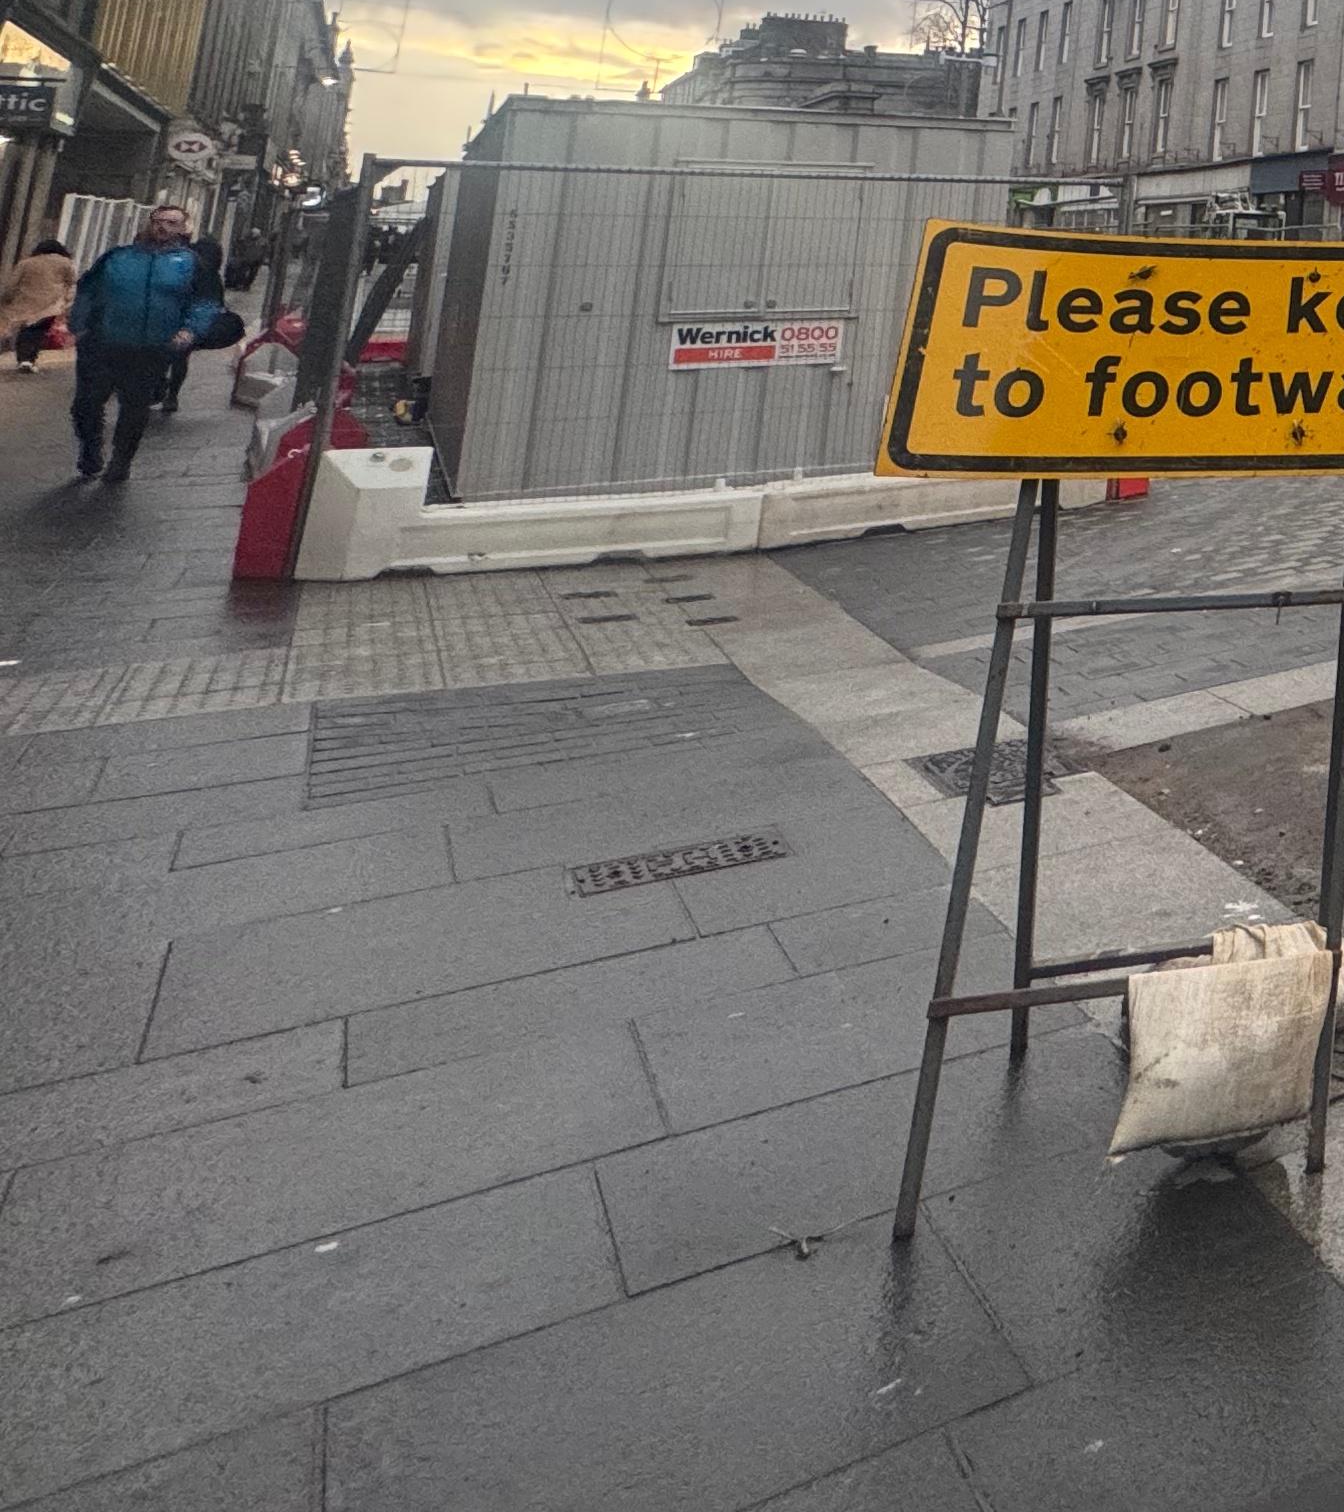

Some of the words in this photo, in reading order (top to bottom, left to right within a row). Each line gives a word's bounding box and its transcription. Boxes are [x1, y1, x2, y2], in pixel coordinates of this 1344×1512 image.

[961, 265, 1251, 335] Please
[676, 325, 777, 346] Wernick
[781, 325, 839, 342] 0800
[707, 348, 743, 360] HIRE
[797, 343, 816, 353] 55
[819, 342, 837, 353] 55
[952, 351, 1044, 418] to
